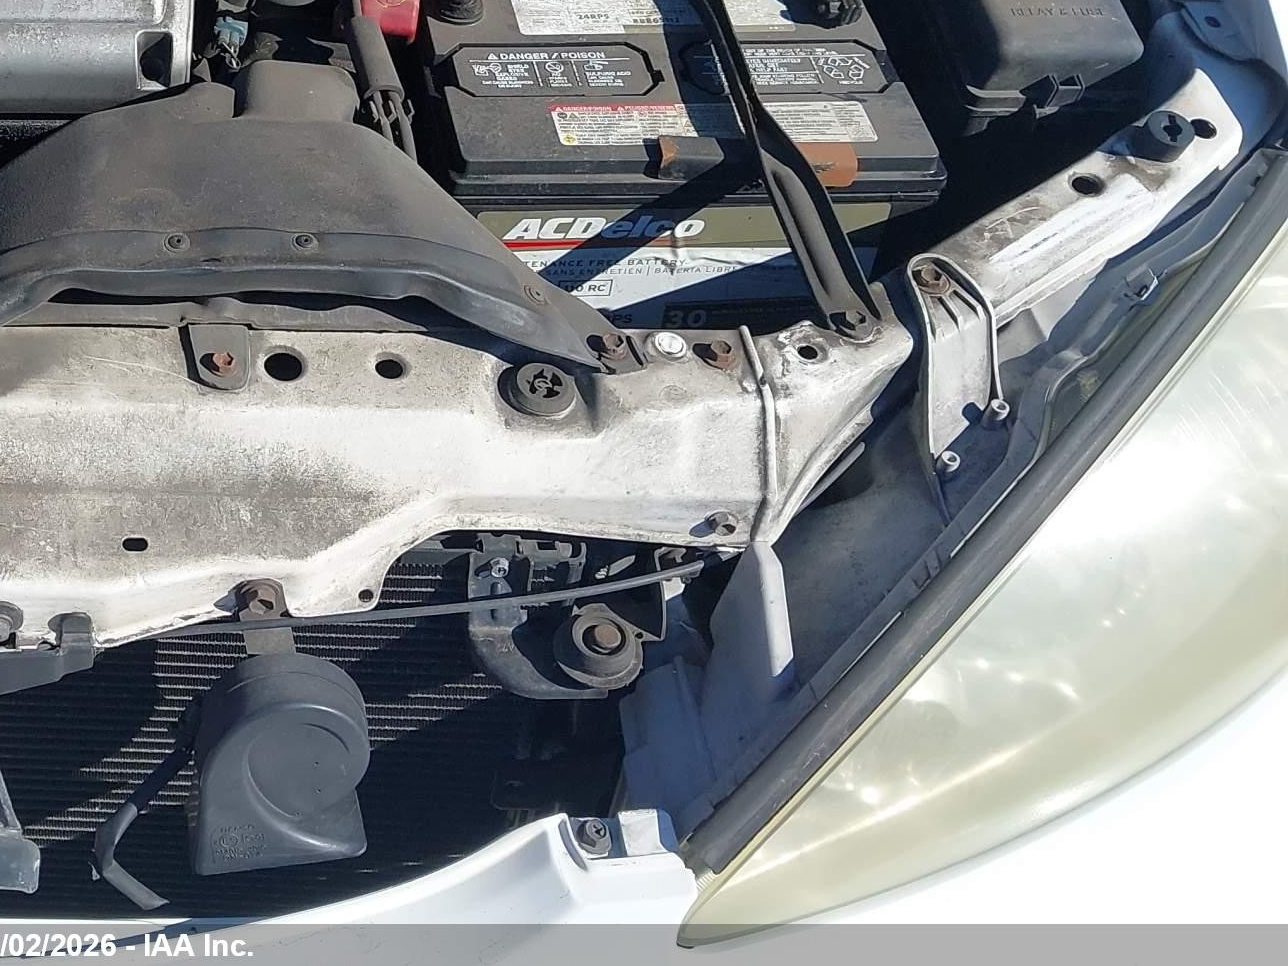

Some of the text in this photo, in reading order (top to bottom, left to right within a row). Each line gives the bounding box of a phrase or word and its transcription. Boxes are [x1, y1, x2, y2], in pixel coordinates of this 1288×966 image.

[499, 52, 549, 60] DANGER
[560, 51, 606, 59] POISON
[502, 215, 705, 239] ACDelco
[589, 259, 620, 267] FREE
[587, 284, 607, 292] RC
[668, 309, 708, 328] 30
